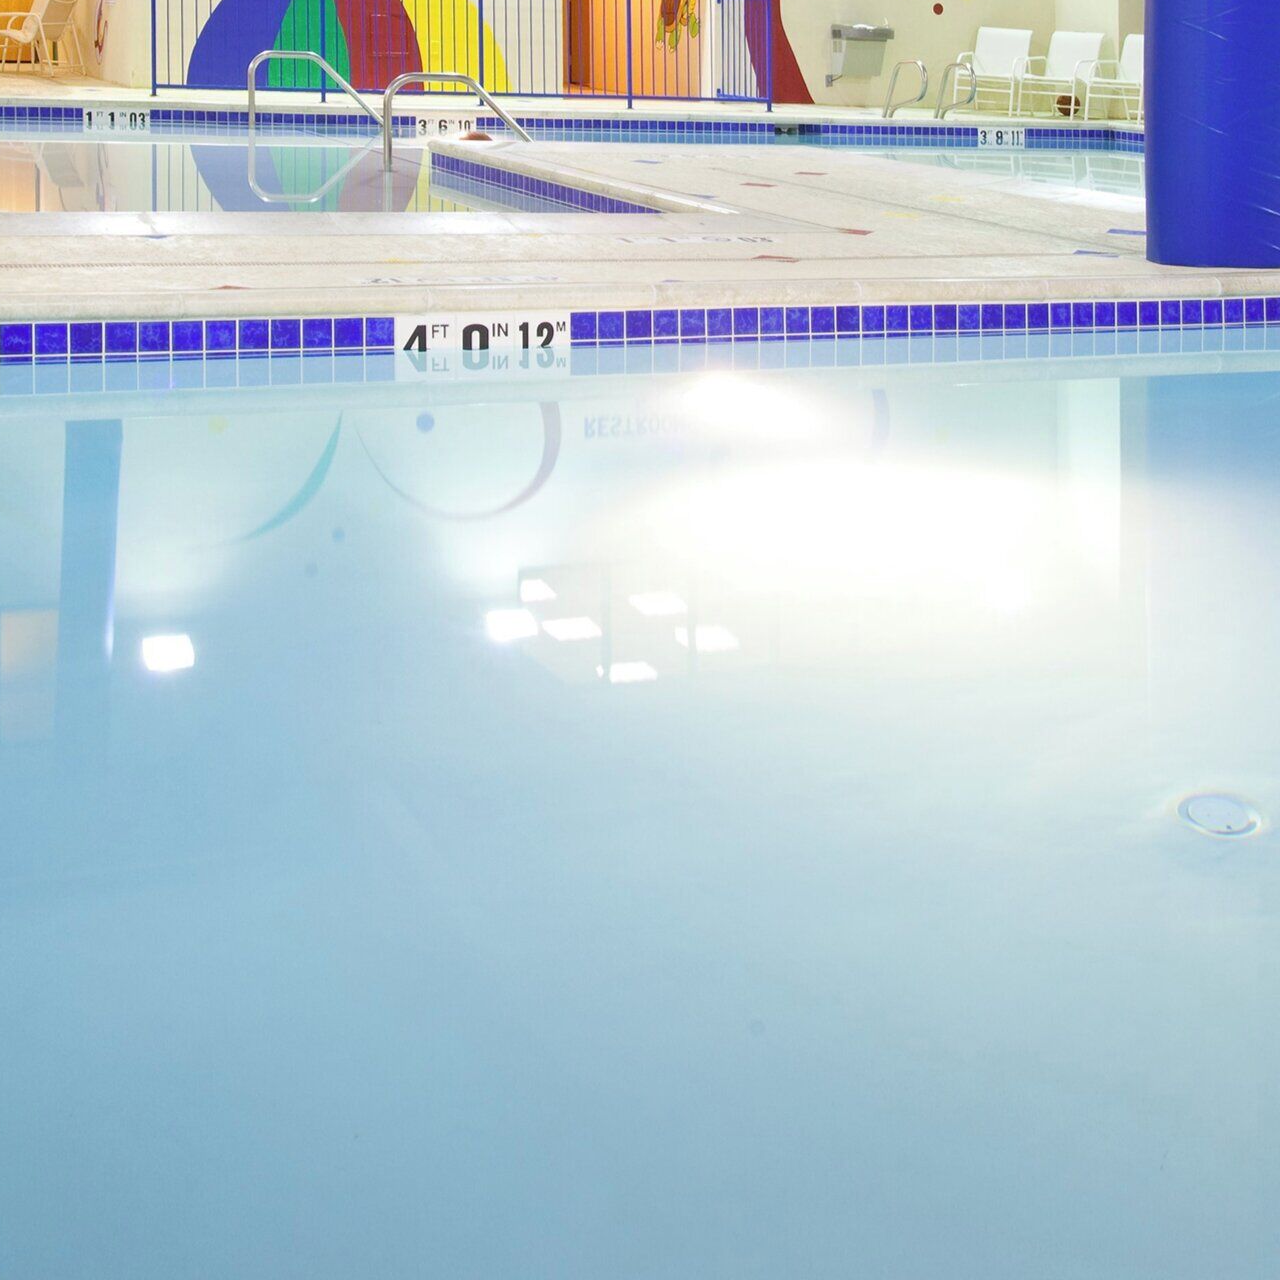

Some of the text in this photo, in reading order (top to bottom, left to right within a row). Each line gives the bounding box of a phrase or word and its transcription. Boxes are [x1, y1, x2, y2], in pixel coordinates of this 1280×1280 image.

[403, 325, 427, 352] 4
[432, 324, 449, 338] FT
[462, 323, 489, 350] 0
[492, 323, 509, 337] IN
[556, 321, 566, 332] M
